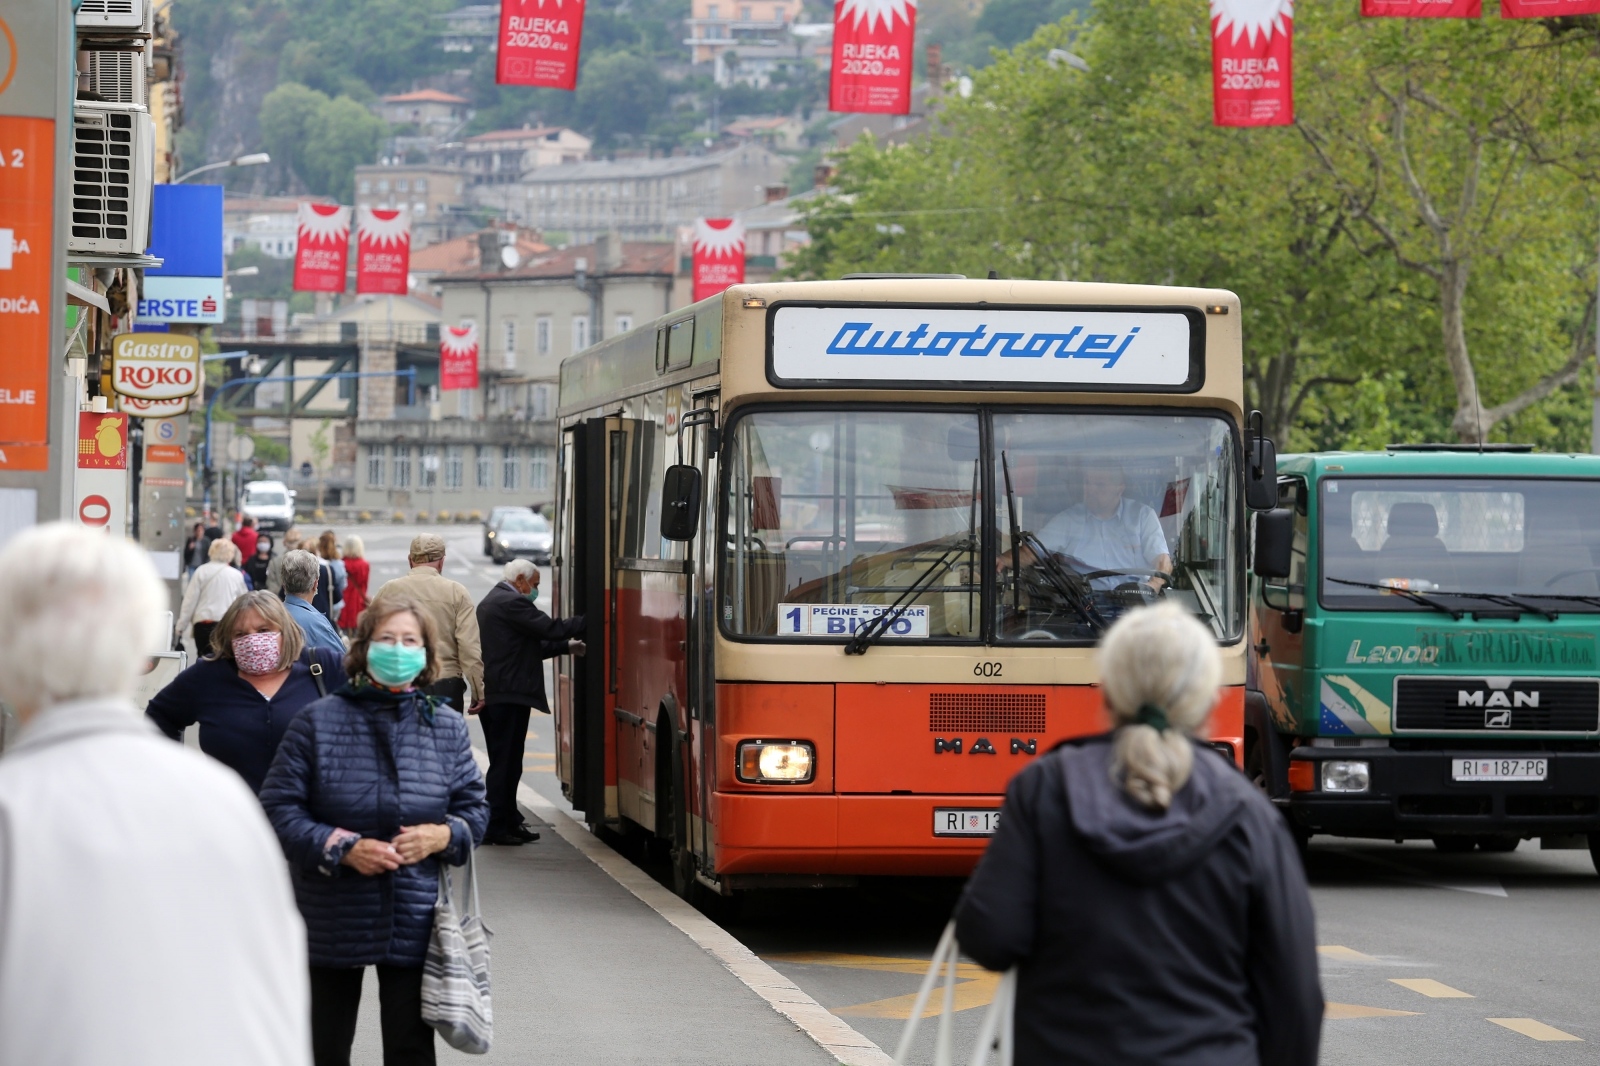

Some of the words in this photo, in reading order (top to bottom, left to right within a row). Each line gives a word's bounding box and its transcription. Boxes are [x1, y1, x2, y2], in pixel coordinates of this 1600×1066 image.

[508, 16, 569, 35] RIJEKA
[506, 32, 568, 51] 2020.eu
[843, 43, 900, 60] RIJEKA
[1221, 57, 1279, 73] RIJEKA
[11, 148, 25, 168] 2
[137, 299, 198, 317] ERSTE
[119, 340, 193, 359] Gastro
[119, 366, 193, 390] ROKO
[786, 607, 801, 633] 1
[812, 607, 858, 616] PEĆINE
[1468, 631, 1555, 664] GRADNJA
[973, 662, 1003, 677] 602
[1458, 690, 1540, 708] MAN
[934, 737, 1037, 755] MAN
[1463, 761, 1478, 775] RI
[947, 813, 965, 830] RI
